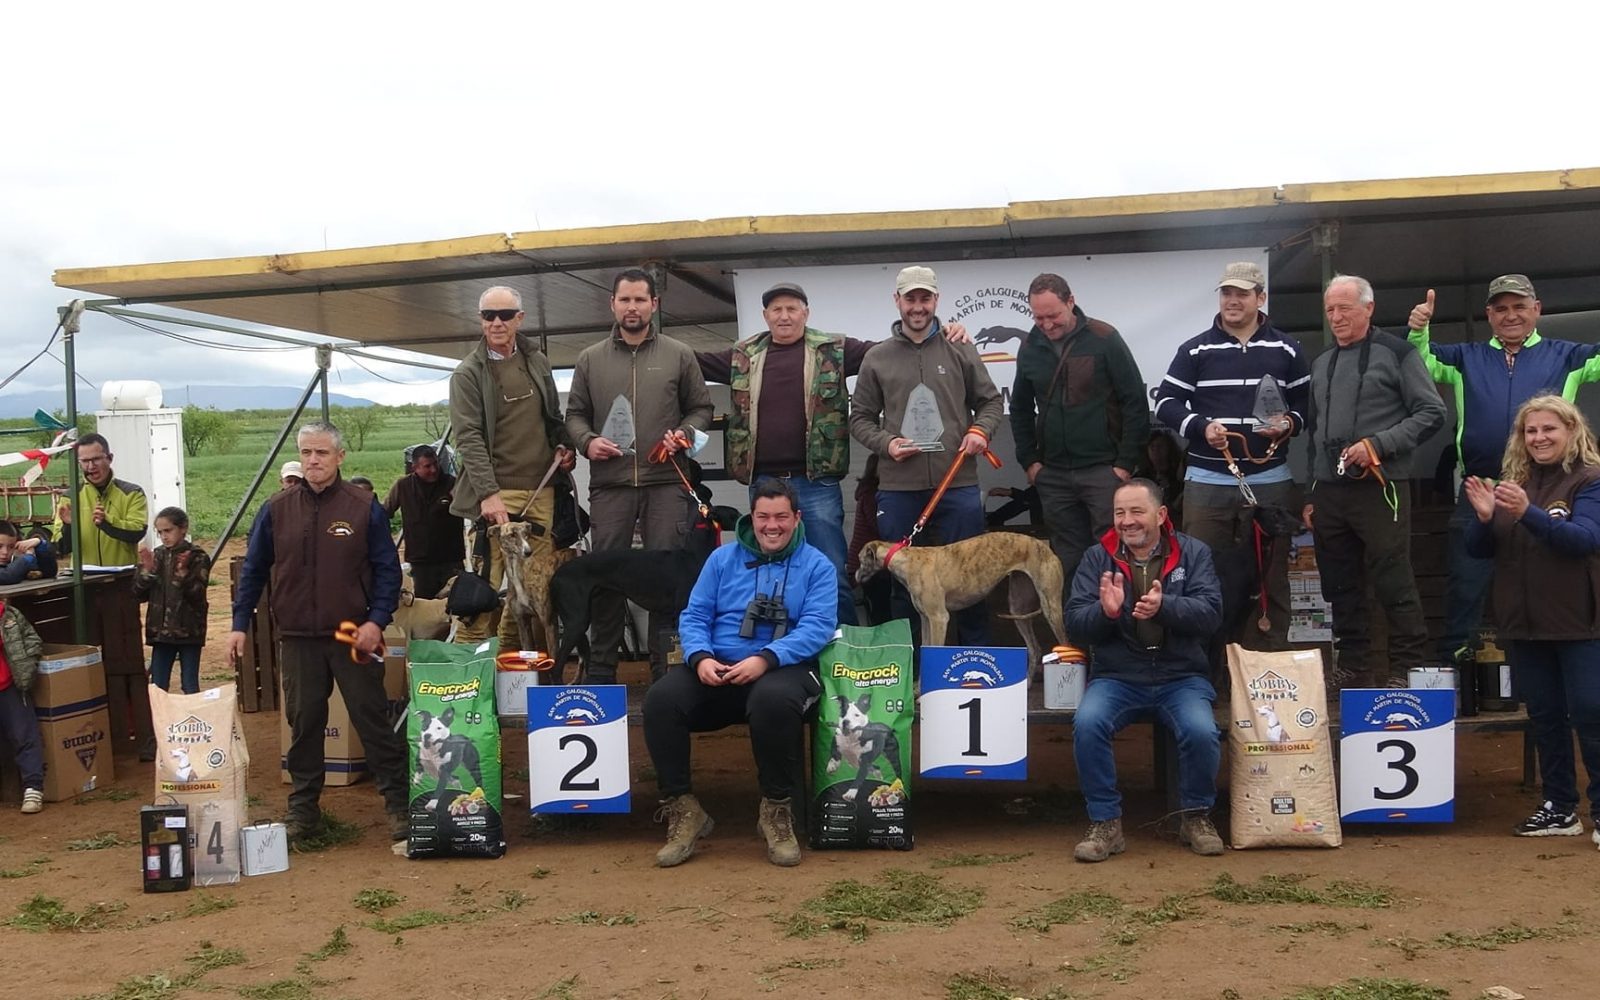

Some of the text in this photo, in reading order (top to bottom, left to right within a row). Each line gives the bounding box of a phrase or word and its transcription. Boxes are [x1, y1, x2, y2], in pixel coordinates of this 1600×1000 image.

[976, 287, 1030, 304] GALGUERO
[990, 300, 1004, 309] DE
[1010, 302, 1034, 319] MON
[833, 664, 899, 680] Enercrock
[418, 678, 480, 695] Enercrock
[958, 698, 988, 756] 1
[1247, 743, 1310, 752] PROFESSIONAL
[559, 733, 600, 791] 2
[1374, 739, 1419, 800] 3
[161, 783, 217, 791] PROFESSIONAL
[207, 821, 224, 864] 4
